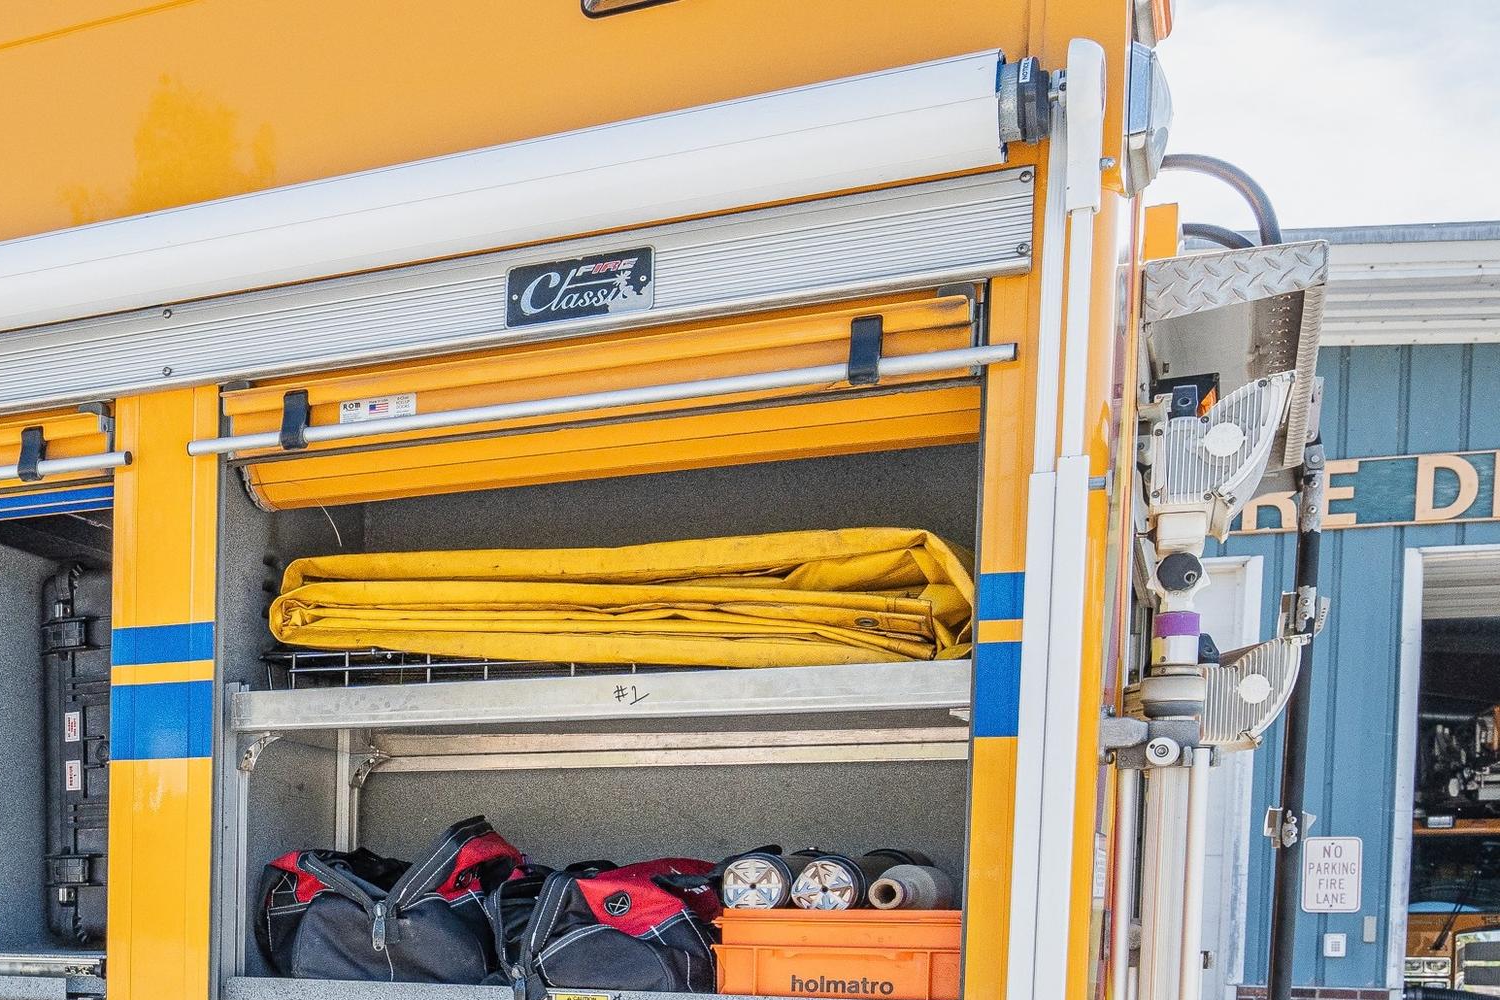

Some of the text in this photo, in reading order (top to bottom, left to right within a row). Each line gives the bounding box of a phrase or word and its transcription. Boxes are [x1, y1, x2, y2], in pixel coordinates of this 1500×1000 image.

[575, 257, 638, 277] FIRE
[1414, 453, 1500, 521] D
[1322, 846, 1342, 858] NO
[1308, 862, 1356, 875] PARKING
[1318, 878, 1344, 890] FIRE
[1316, 893, 1346, 904] LANE
[791, 975, 894, 995] holmatro
